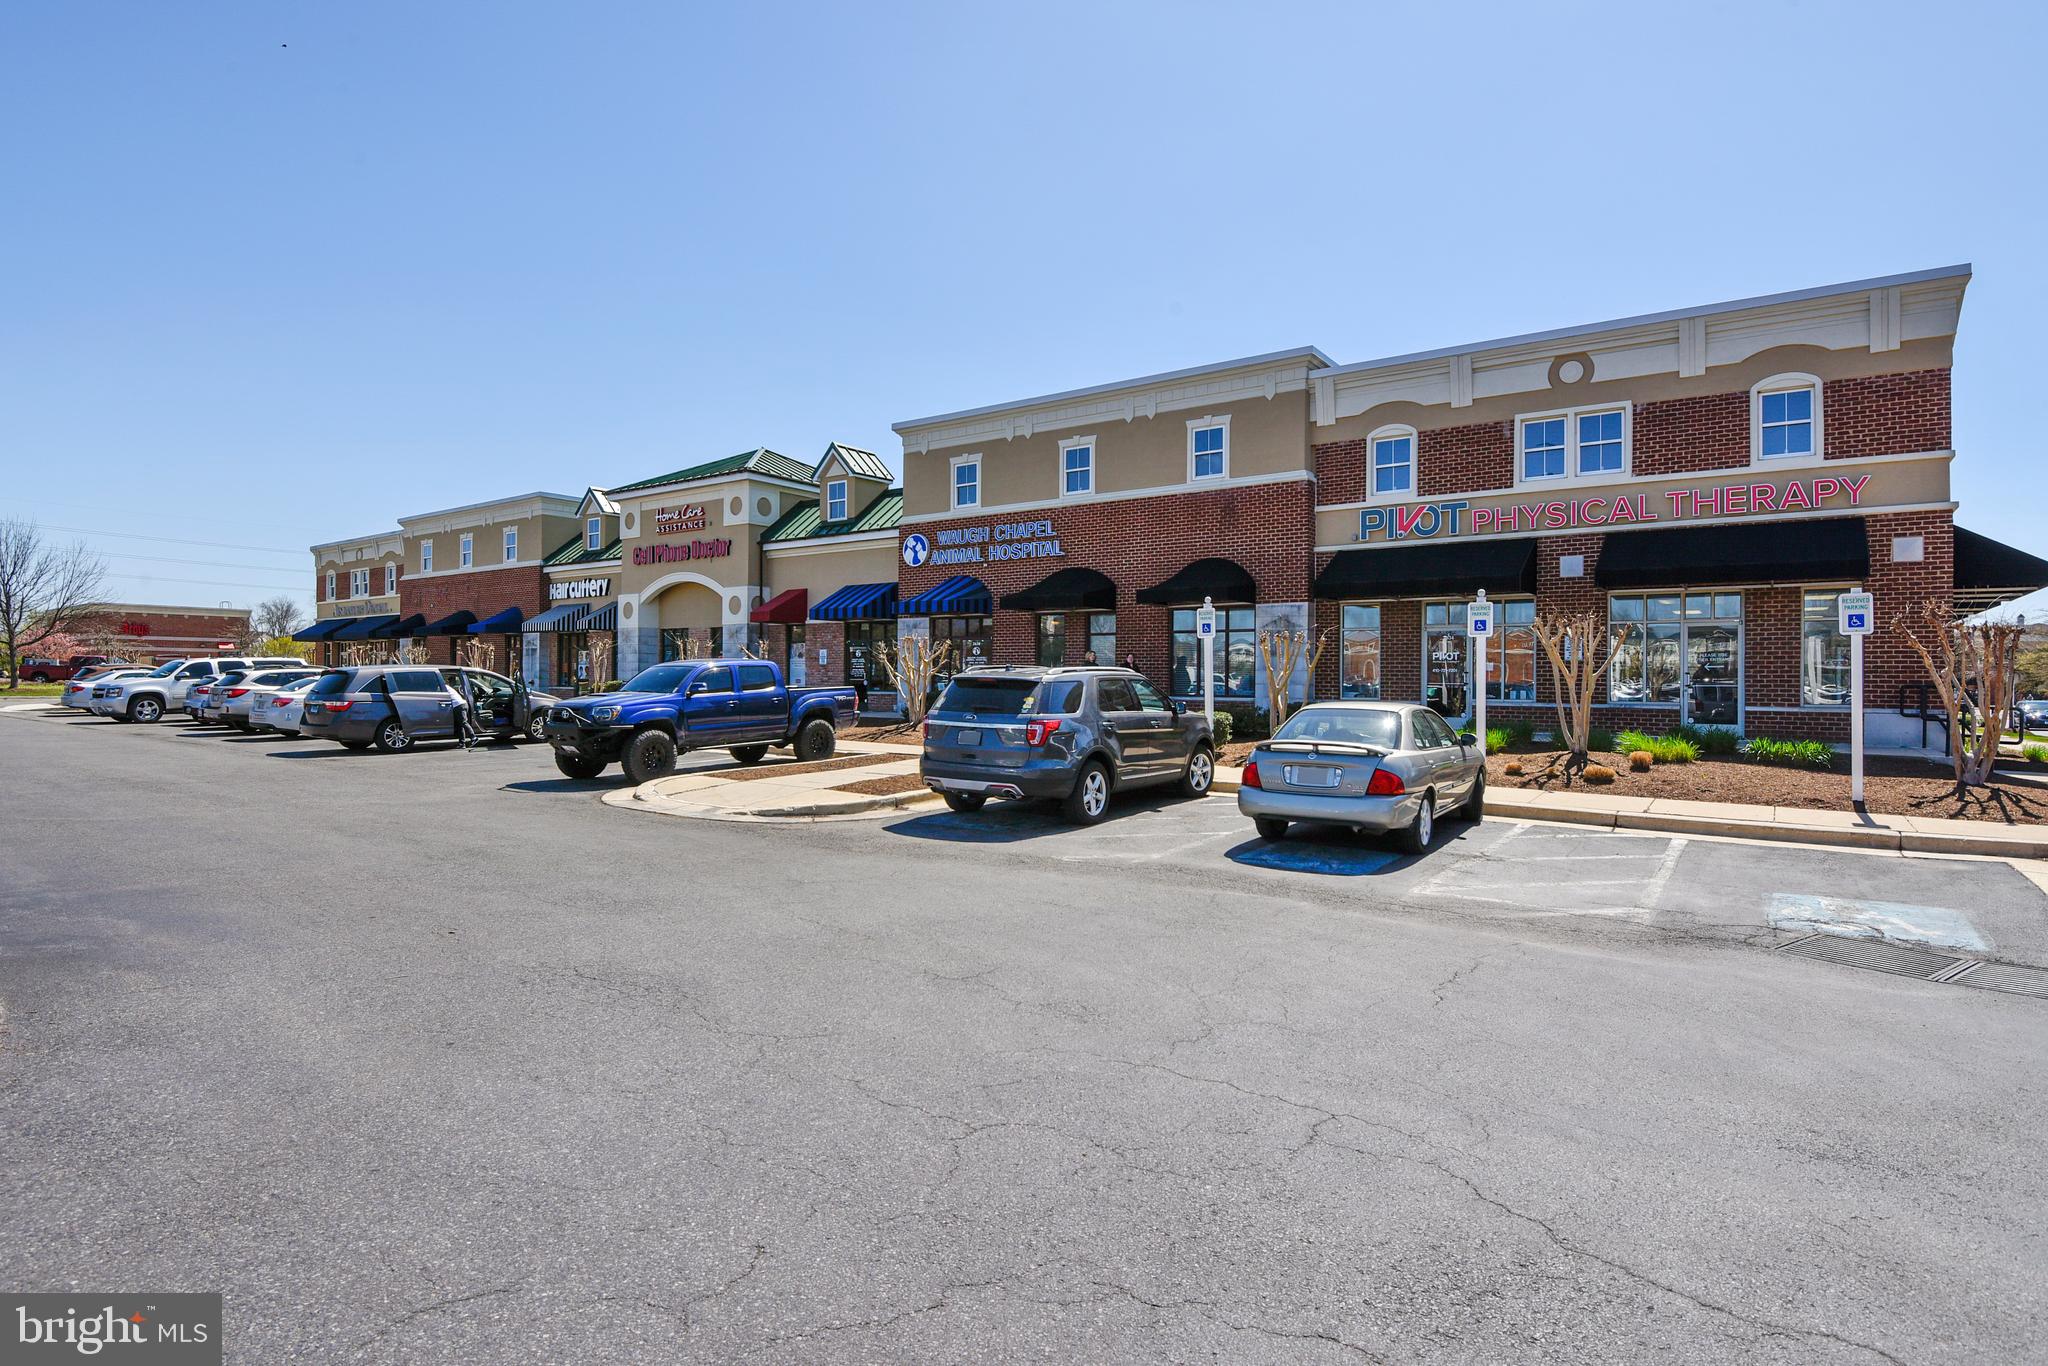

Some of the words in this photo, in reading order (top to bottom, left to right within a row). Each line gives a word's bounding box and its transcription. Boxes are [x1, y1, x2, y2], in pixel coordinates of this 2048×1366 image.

[656, 507, 679, 522] Home
[681, 504, 704, 519] Care
[1359, 501, 1468, 541] PIVOT
[1472, 495, 1658, 533] PHYSICAL
[1666, 474, 1873, 518] THERAPY
[656, 521, 704, 533] ASSISTANCE
[937, 526, 989, 546] WAUGH
[994, 520, 1057, 540] CHAPEL
[633, 547, 655, 565] Cell
[656, 543, 690, 563] Phone
[691, 539, 731, 560] Doctor
[930, 547, 984, 565] ANIMAL
[988, 540, 1066, 561] HOSPITAL
[1432, 651, 1460, 661] PIVOT
